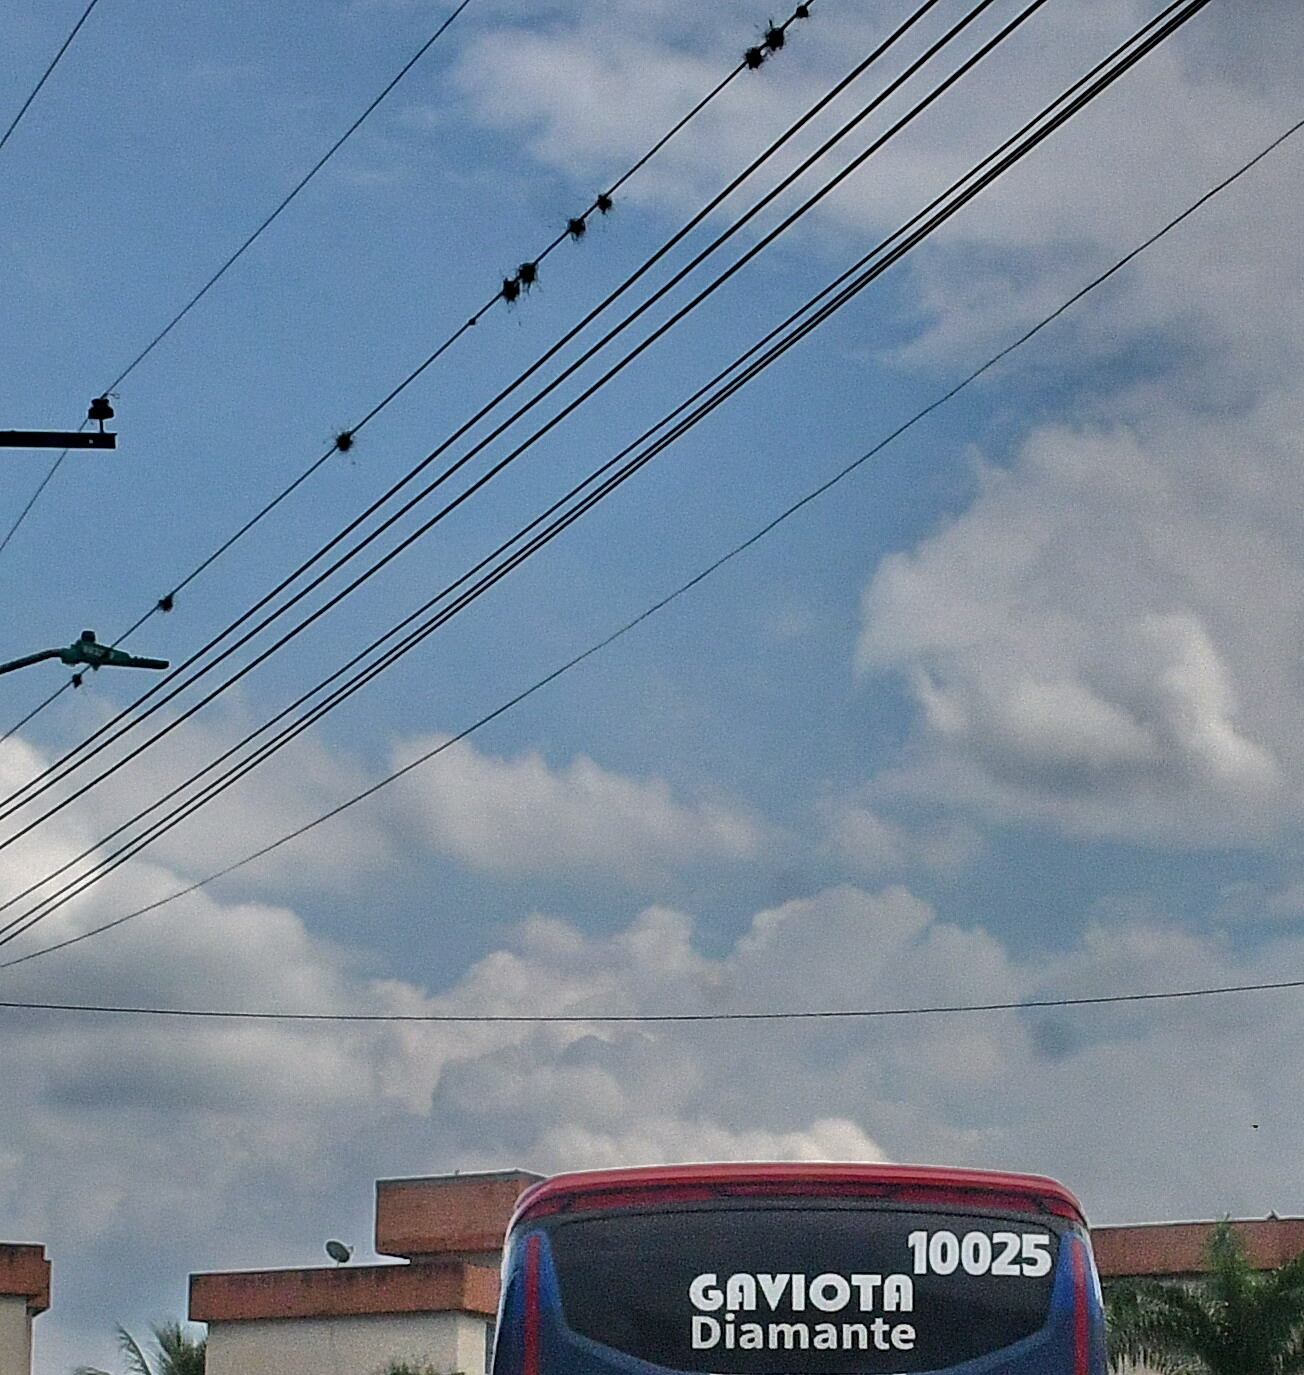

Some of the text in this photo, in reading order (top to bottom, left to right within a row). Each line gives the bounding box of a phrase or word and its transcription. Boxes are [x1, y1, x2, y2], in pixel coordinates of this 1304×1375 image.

[907, 1231, 1052, 1277] 10025
[688, 1273, 914, 1312] GAVIOTA
[690, 1314, 916, 1350] Diamante
